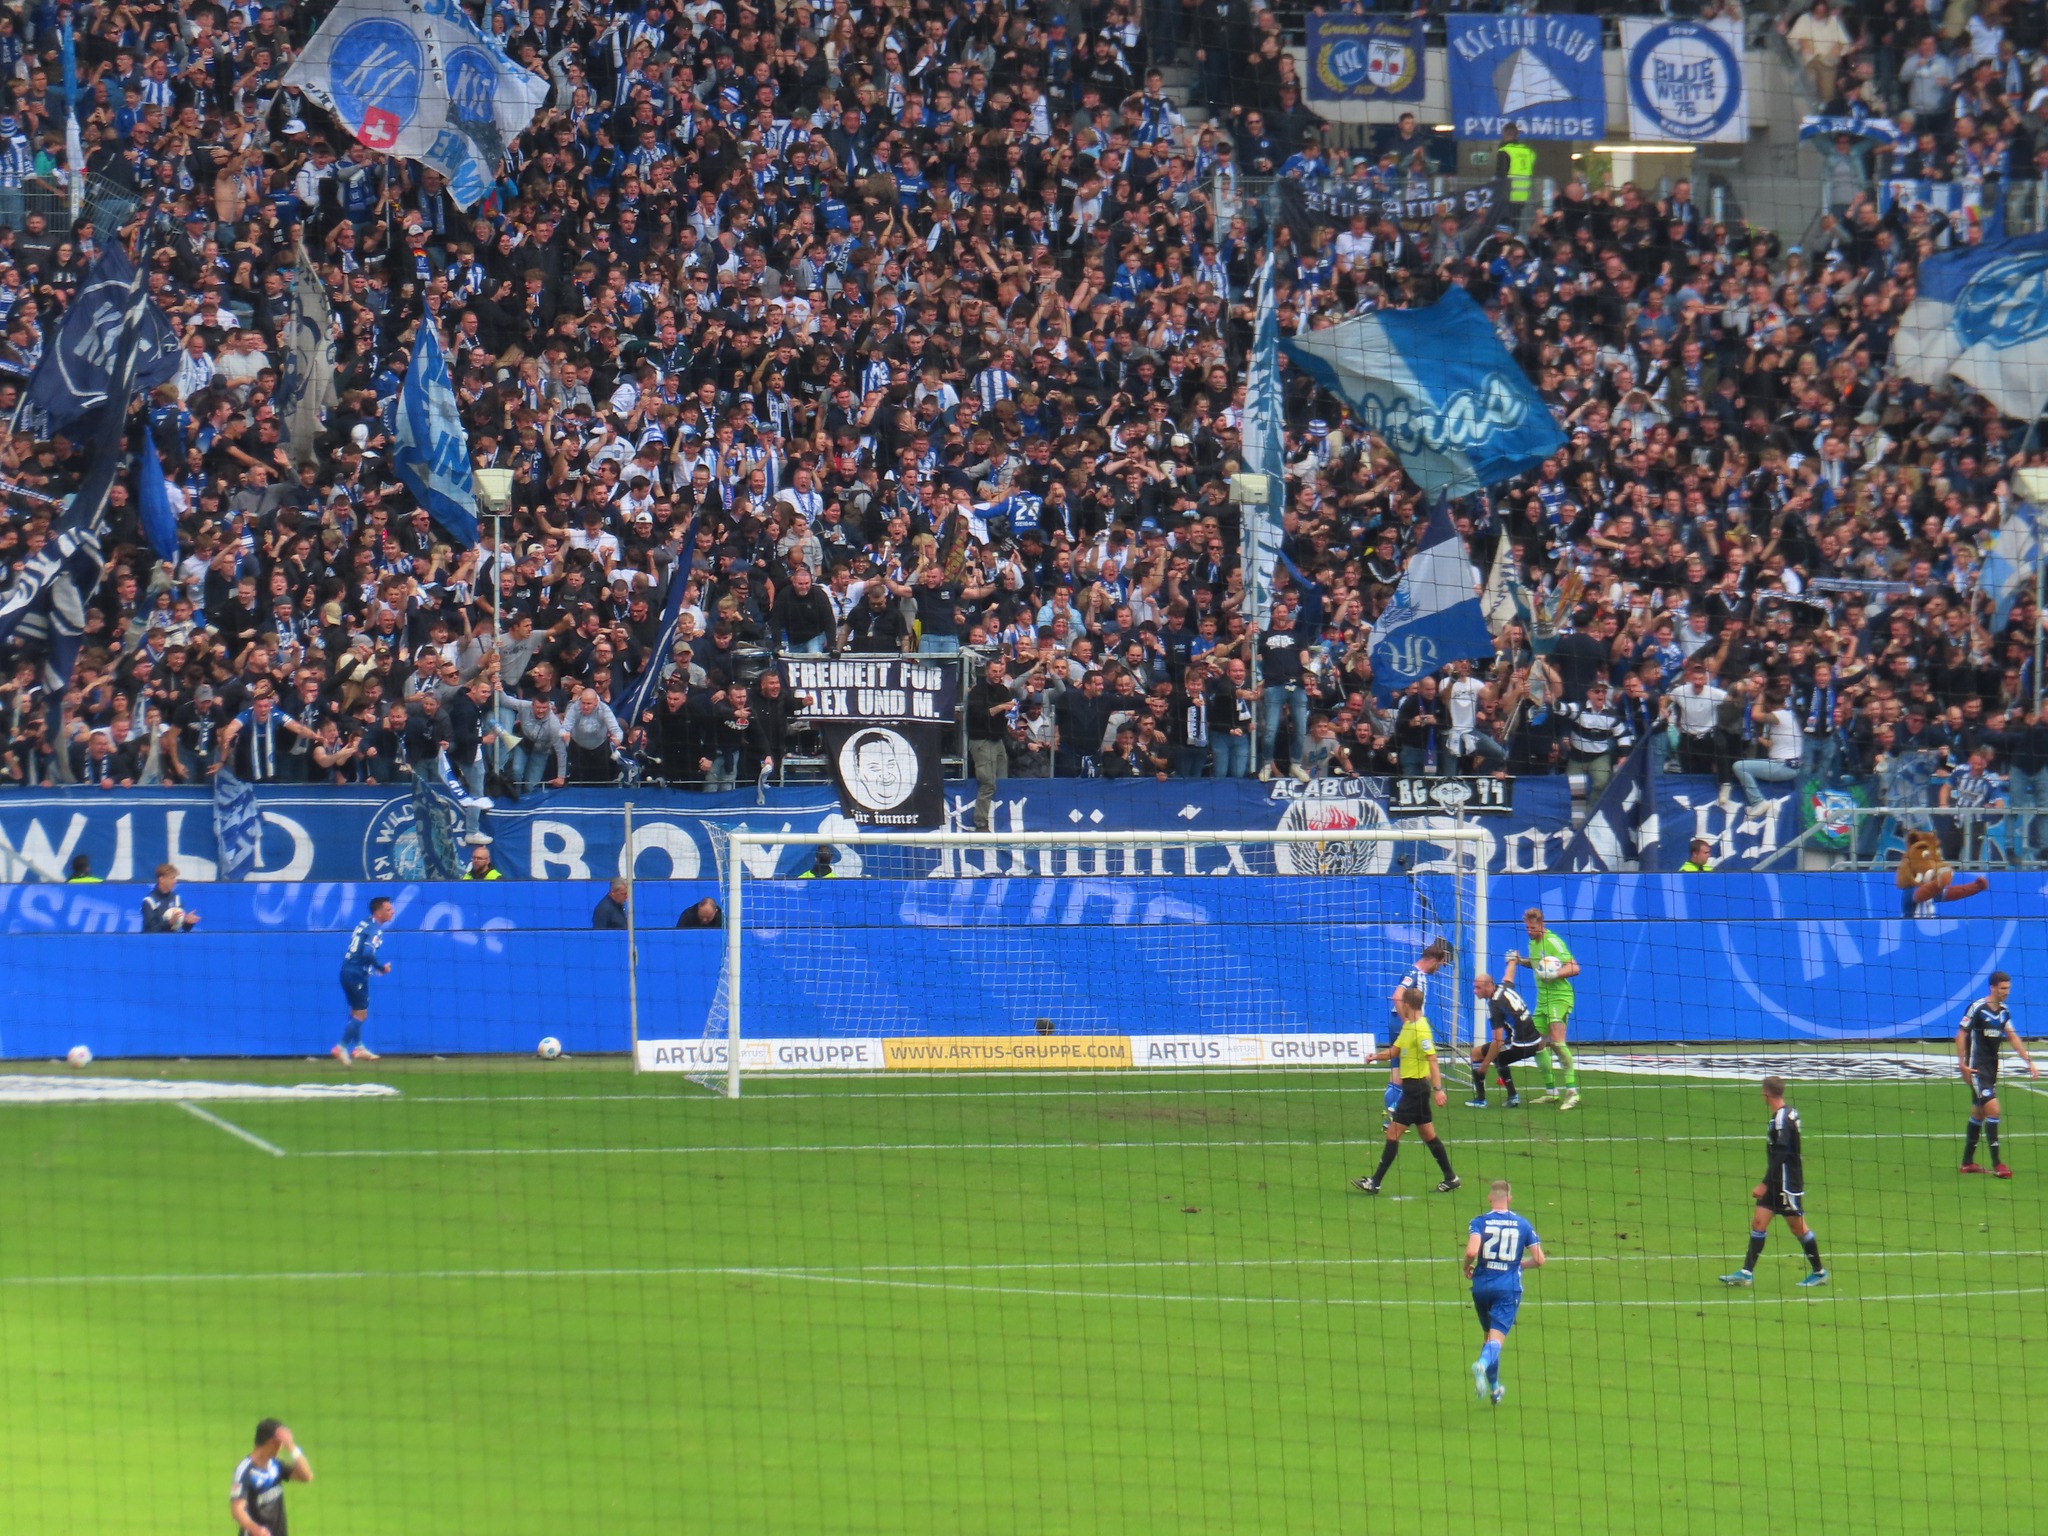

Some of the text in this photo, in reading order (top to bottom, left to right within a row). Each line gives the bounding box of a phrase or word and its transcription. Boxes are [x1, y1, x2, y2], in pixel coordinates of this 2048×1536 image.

[1545, 19, 1597, 62] CLUB
[1653, 58, 1714, 82] BLUE
[1655, 80, 1716, 100] WHITE
[787, 662, 891, 688] FREIHEIT
[857, 689, 906, 716] UND
[1270, 778, 1339, 798] ACAB
[850, 810, 919, 824] ür immer
[0, 810, 315, 882] WILD
[655, 1046, 728, 1064] ARTUS
[778, 1044, 869, 1063] GRUPPE
[890, 1043, 1126, 1060] WWW.ARTUS-GRUPPE.COM
[1148, 1042, 1221, 1060] ARTUS
[1271, 1040, 1359, 1057] GRUPPE
[1482, 1226, 1519, 1261] 20
